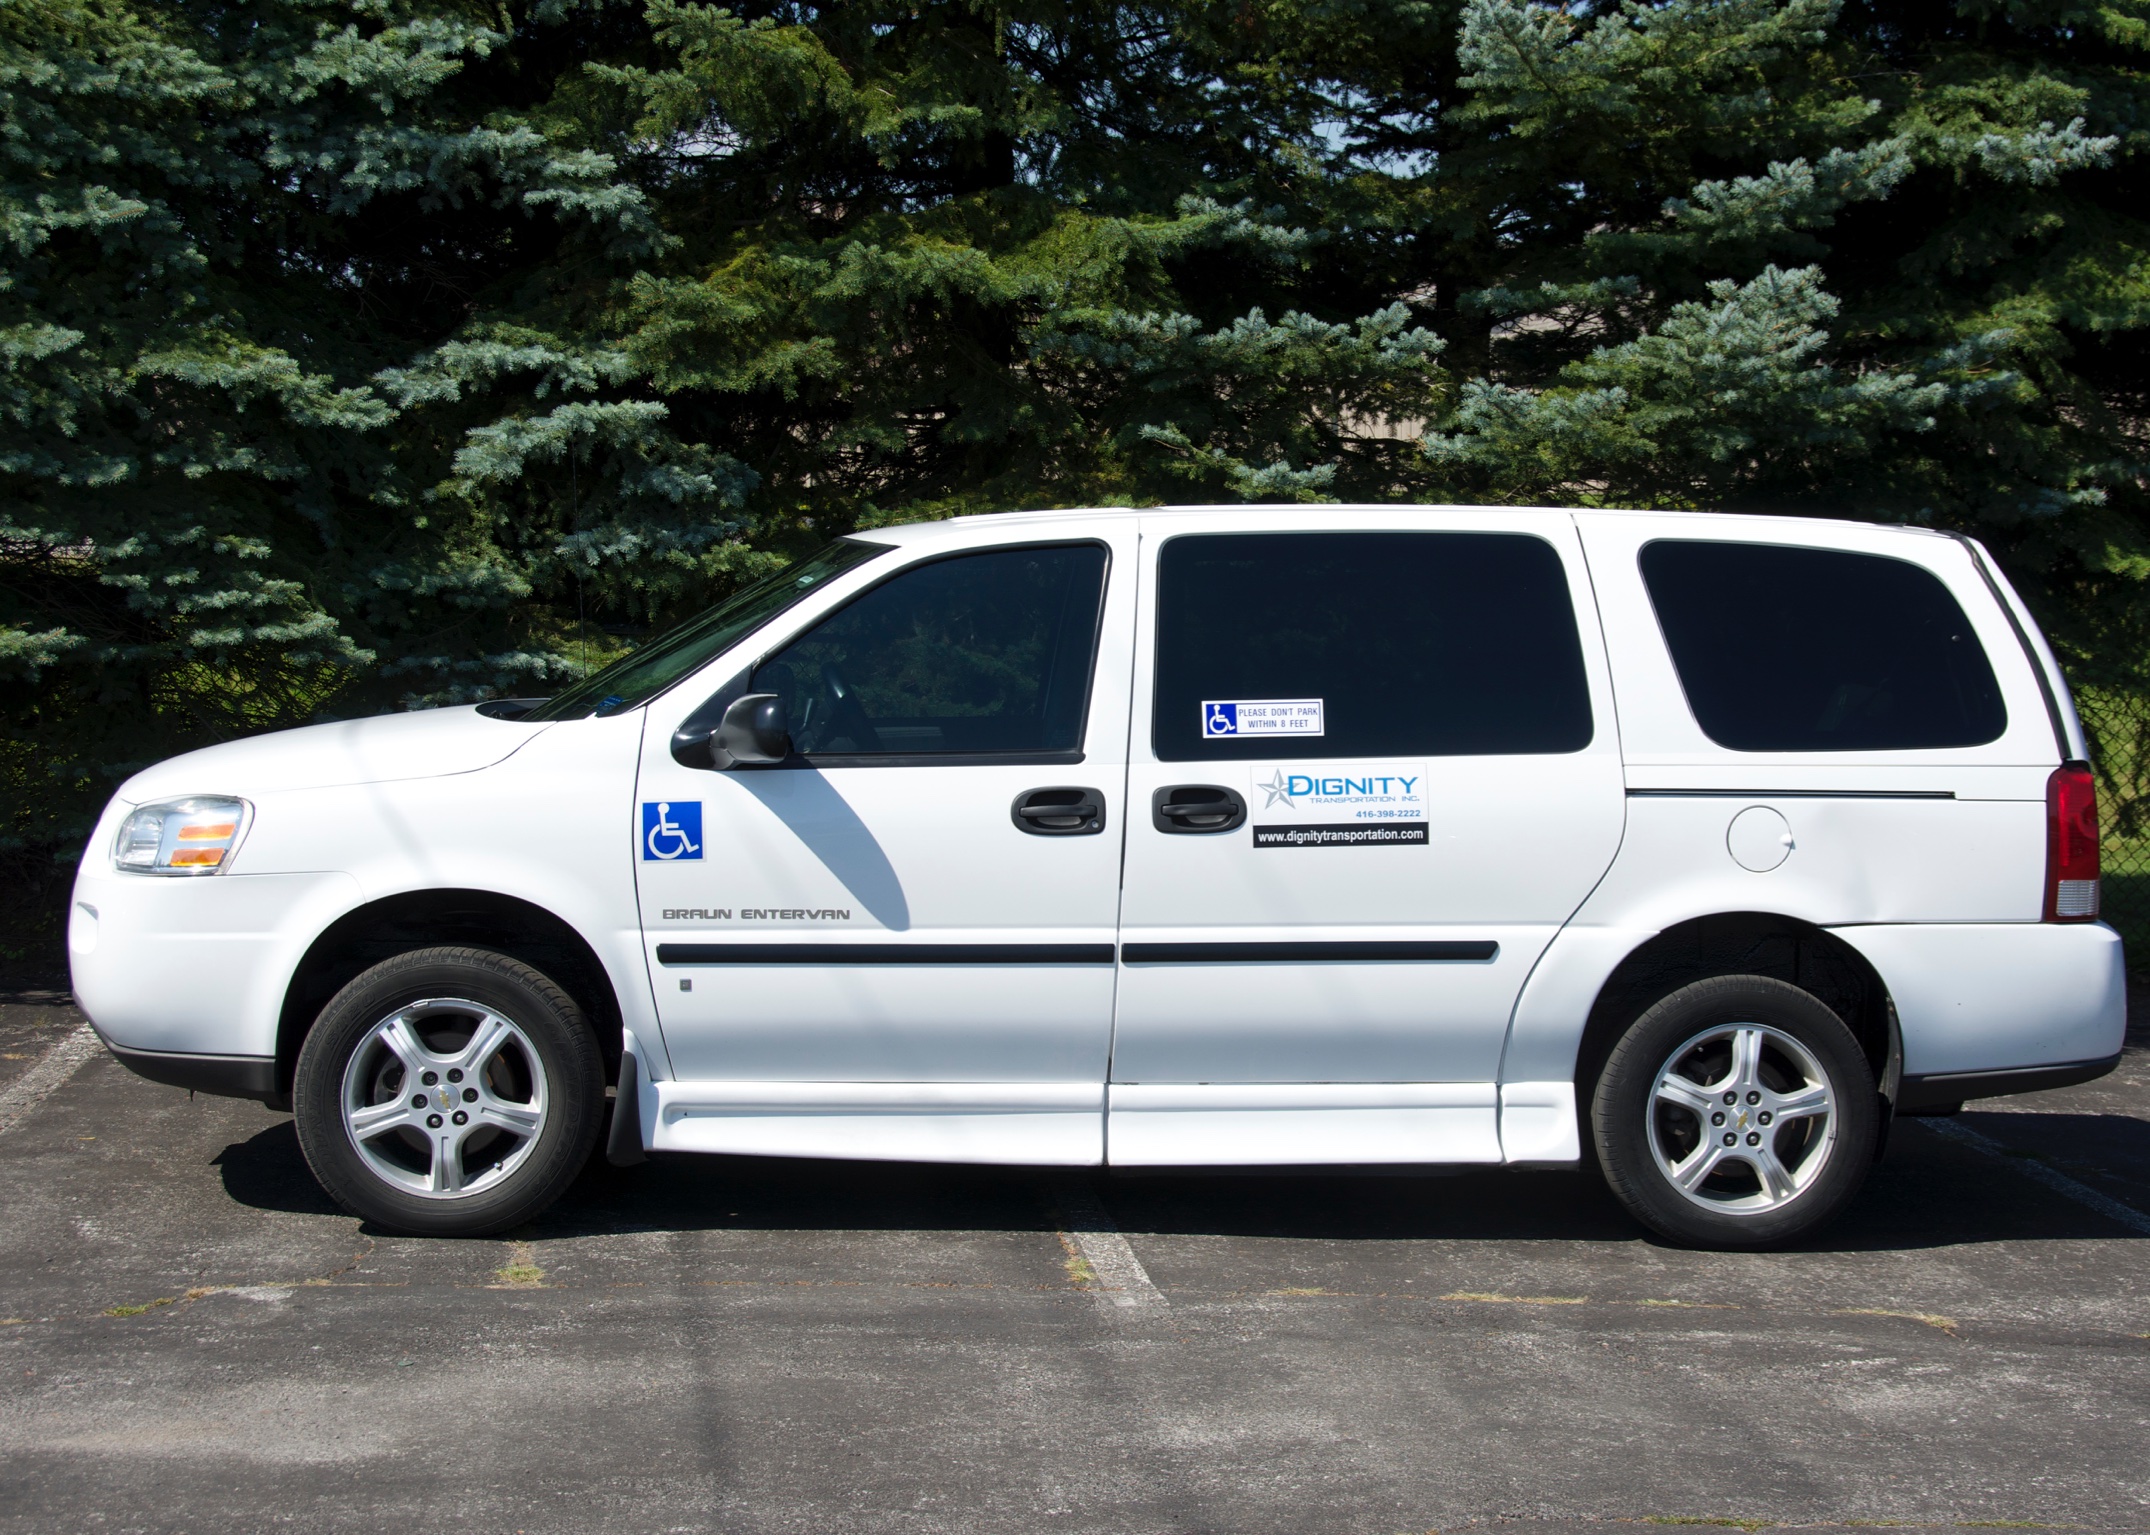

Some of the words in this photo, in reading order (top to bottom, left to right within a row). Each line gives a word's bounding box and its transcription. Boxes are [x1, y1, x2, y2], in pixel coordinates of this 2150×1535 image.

[1238, 708, 1267, 717] PLEASE
[1271, 707, 1294, 716] DON'T
[1297, 707, 1318, 716] PARK
[1248, 719, 1277, 728] WITHIN
[1281, 719, 1286, 728] 8
[1290, 719, 1309, 728] FEET
[1288, 775, 1419, 796] DIGNITY
[1309, 796, 1396, 804] TRANSPORTATION
[1356, 809, 1421, 818] 416-398-2222
[1258, 828, 1424, 844] www.dignitytransportation.com
[662, 908, 732, 920] BRAUN
[740, 908, 851, 920] ENTERVAN
